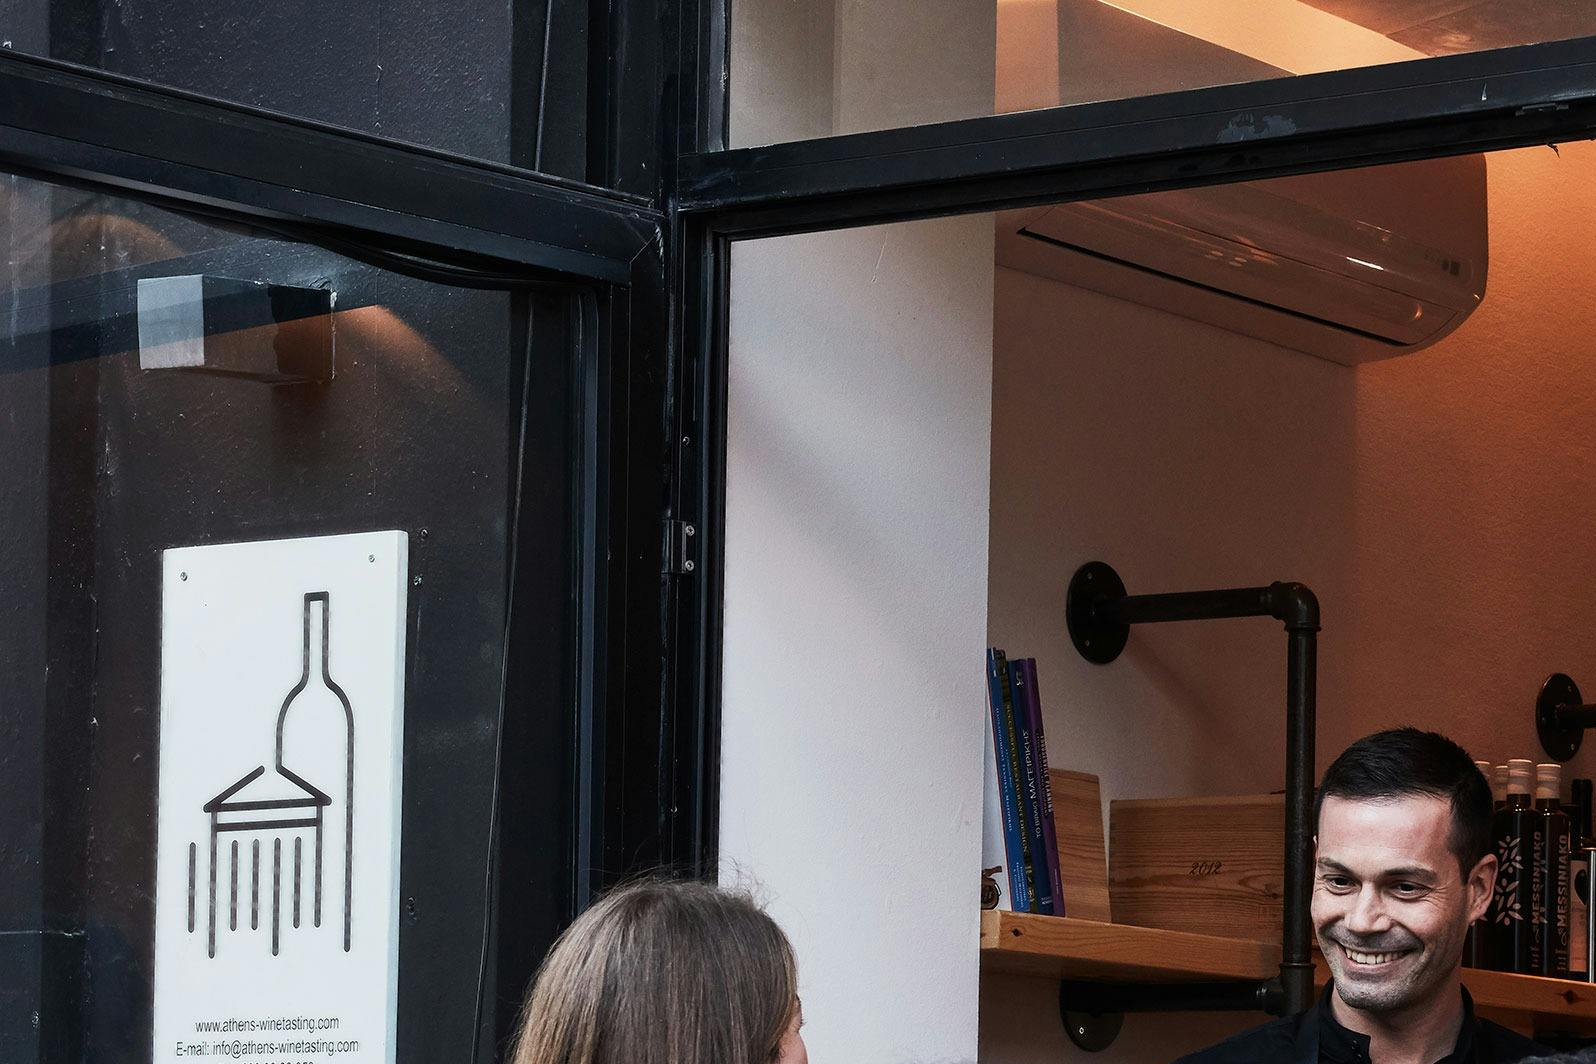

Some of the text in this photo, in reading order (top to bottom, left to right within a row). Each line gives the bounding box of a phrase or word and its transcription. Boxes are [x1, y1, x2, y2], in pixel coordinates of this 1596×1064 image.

[1022, 728, 1036, 799] ΜΑΓΕΙΡΙΚΗΣ
[1189, 860, 1222, 876] 2012
[1556, 835, 1568, 928] MESSINIAKO
[195, 1016, 339, 1033] www.athens-winetasting.com
[176, 1039, 359, 1058] E-mail: info@athens-winetasting.com
